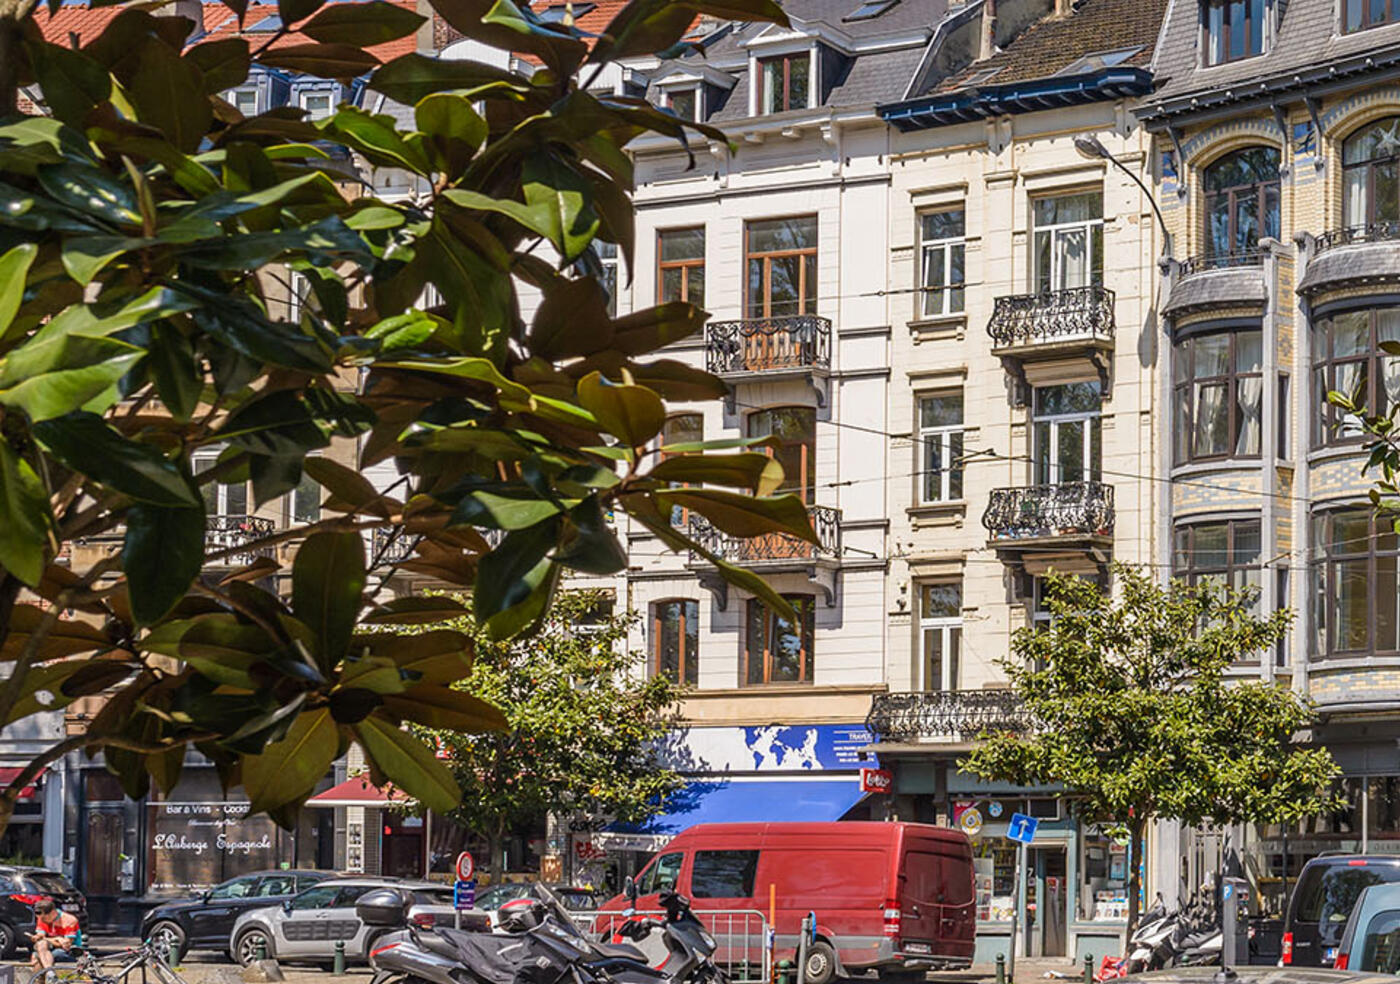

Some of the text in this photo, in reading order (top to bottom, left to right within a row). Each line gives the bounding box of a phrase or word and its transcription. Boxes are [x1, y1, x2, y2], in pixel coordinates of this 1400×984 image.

[166, 805, 182, 814] Bar
[192, 805, 211, 814] Vins
[216, 834, 271, 854] Espagnole
